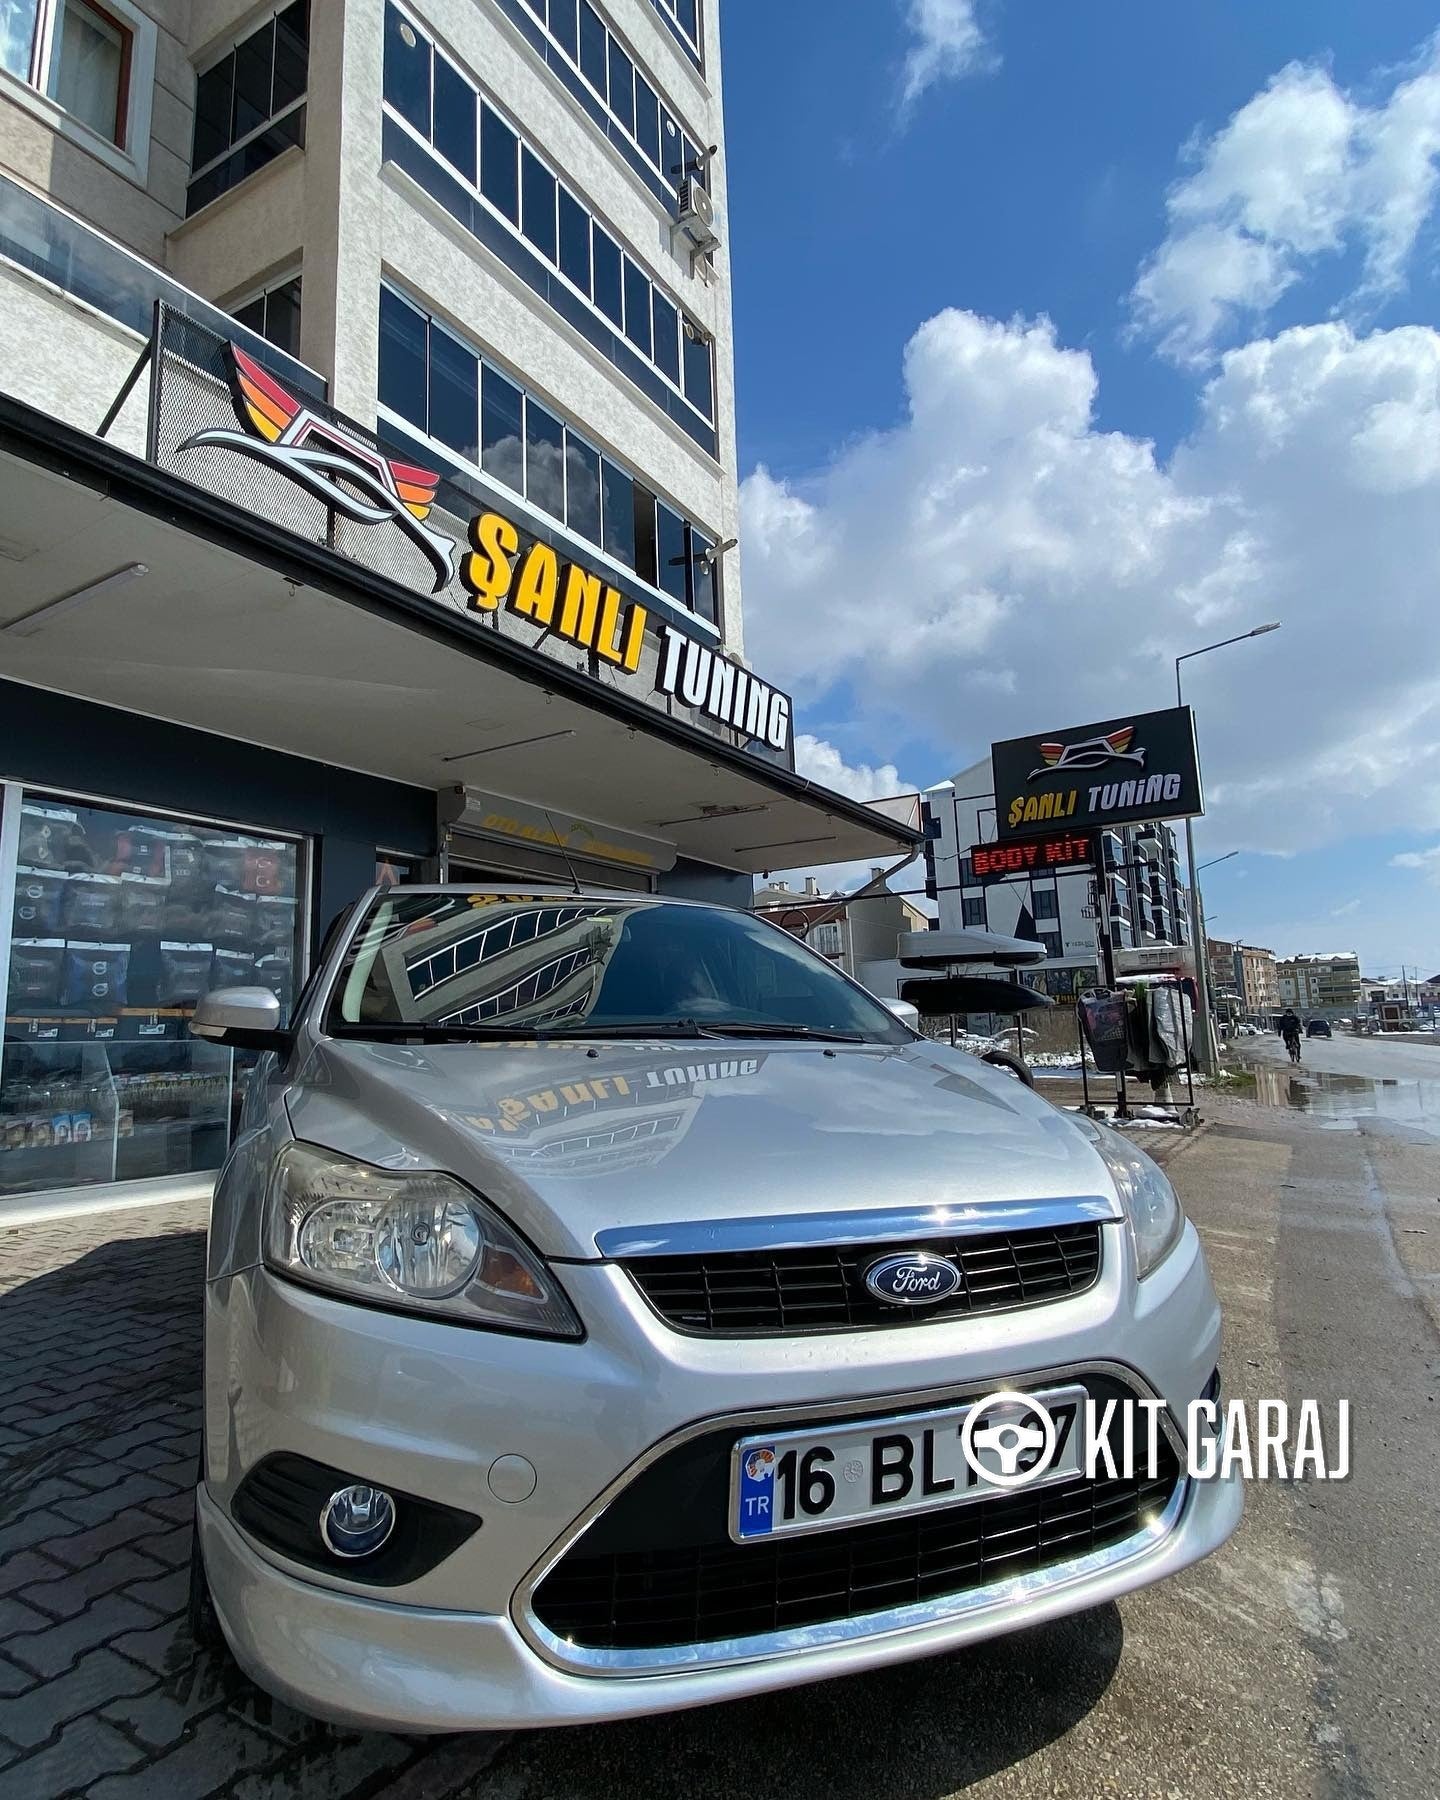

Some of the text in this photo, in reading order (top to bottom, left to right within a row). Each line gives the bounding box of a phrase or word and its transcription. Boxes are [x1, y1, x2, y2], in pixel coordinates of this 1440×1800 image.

[467, 511, 789, 752] ŞANLI TUNING
[1008, 789, 1078, 829] ŞANLI
[973, 846, 1038, 875] BODY
[892, 1265, 942, 1294] Ford
[777, 1445, 836, 1521] 16
[744, 1494, 771, 1517] TR
